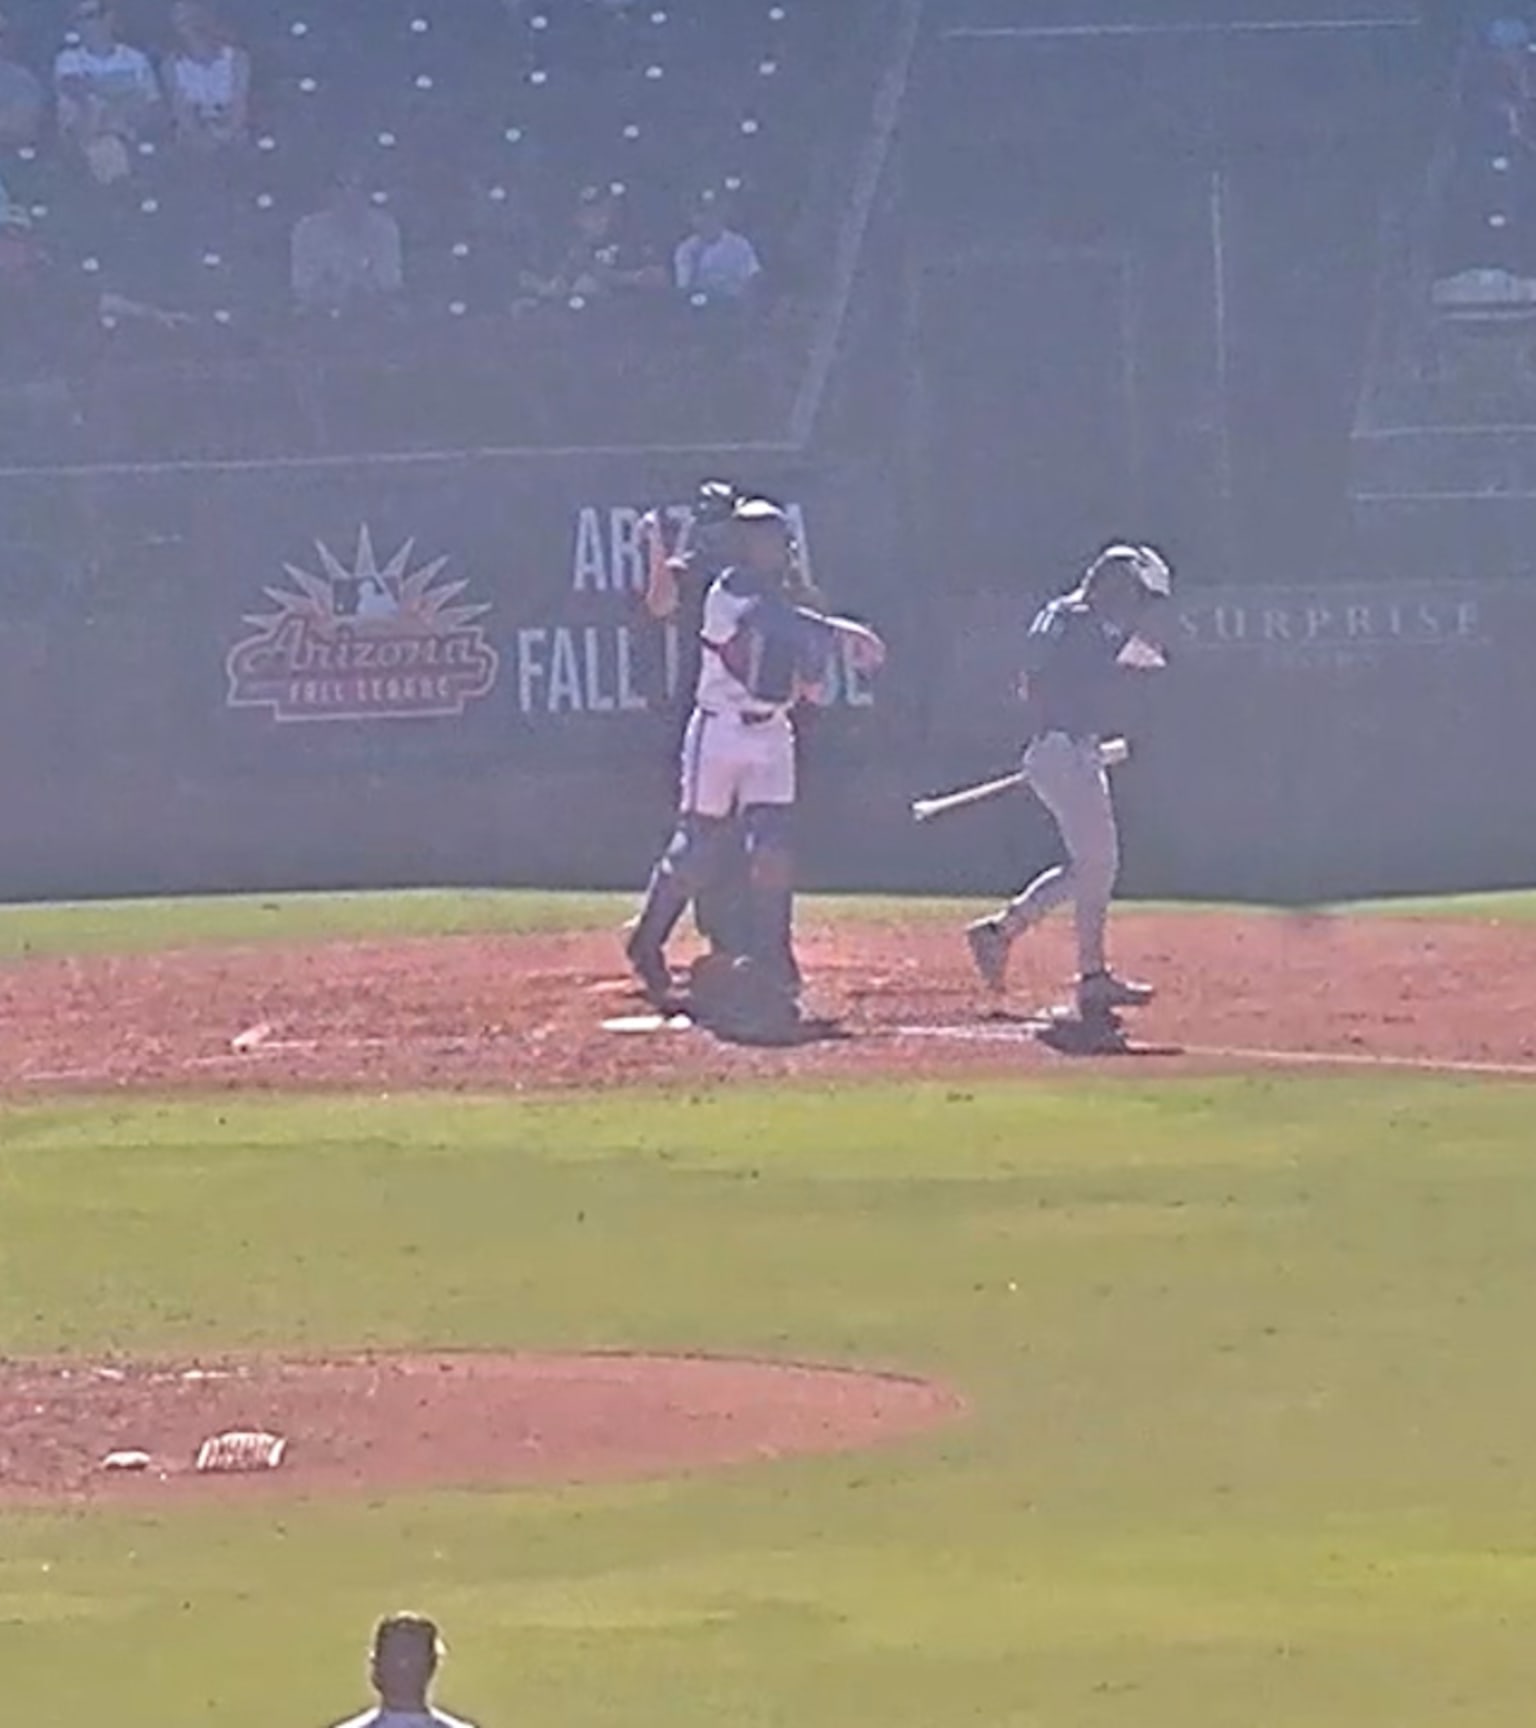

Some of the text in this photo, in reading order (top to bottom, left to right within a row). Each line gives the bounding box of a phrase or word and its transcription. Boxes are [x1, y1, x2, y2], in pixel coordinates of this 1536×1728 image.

[1177, 600, 1479, 640] SURPRISE
[241, 617, 486, 676] Arizona
[517, 626, 648, 713] FALL
[288, 679, 345, 703] FALL
